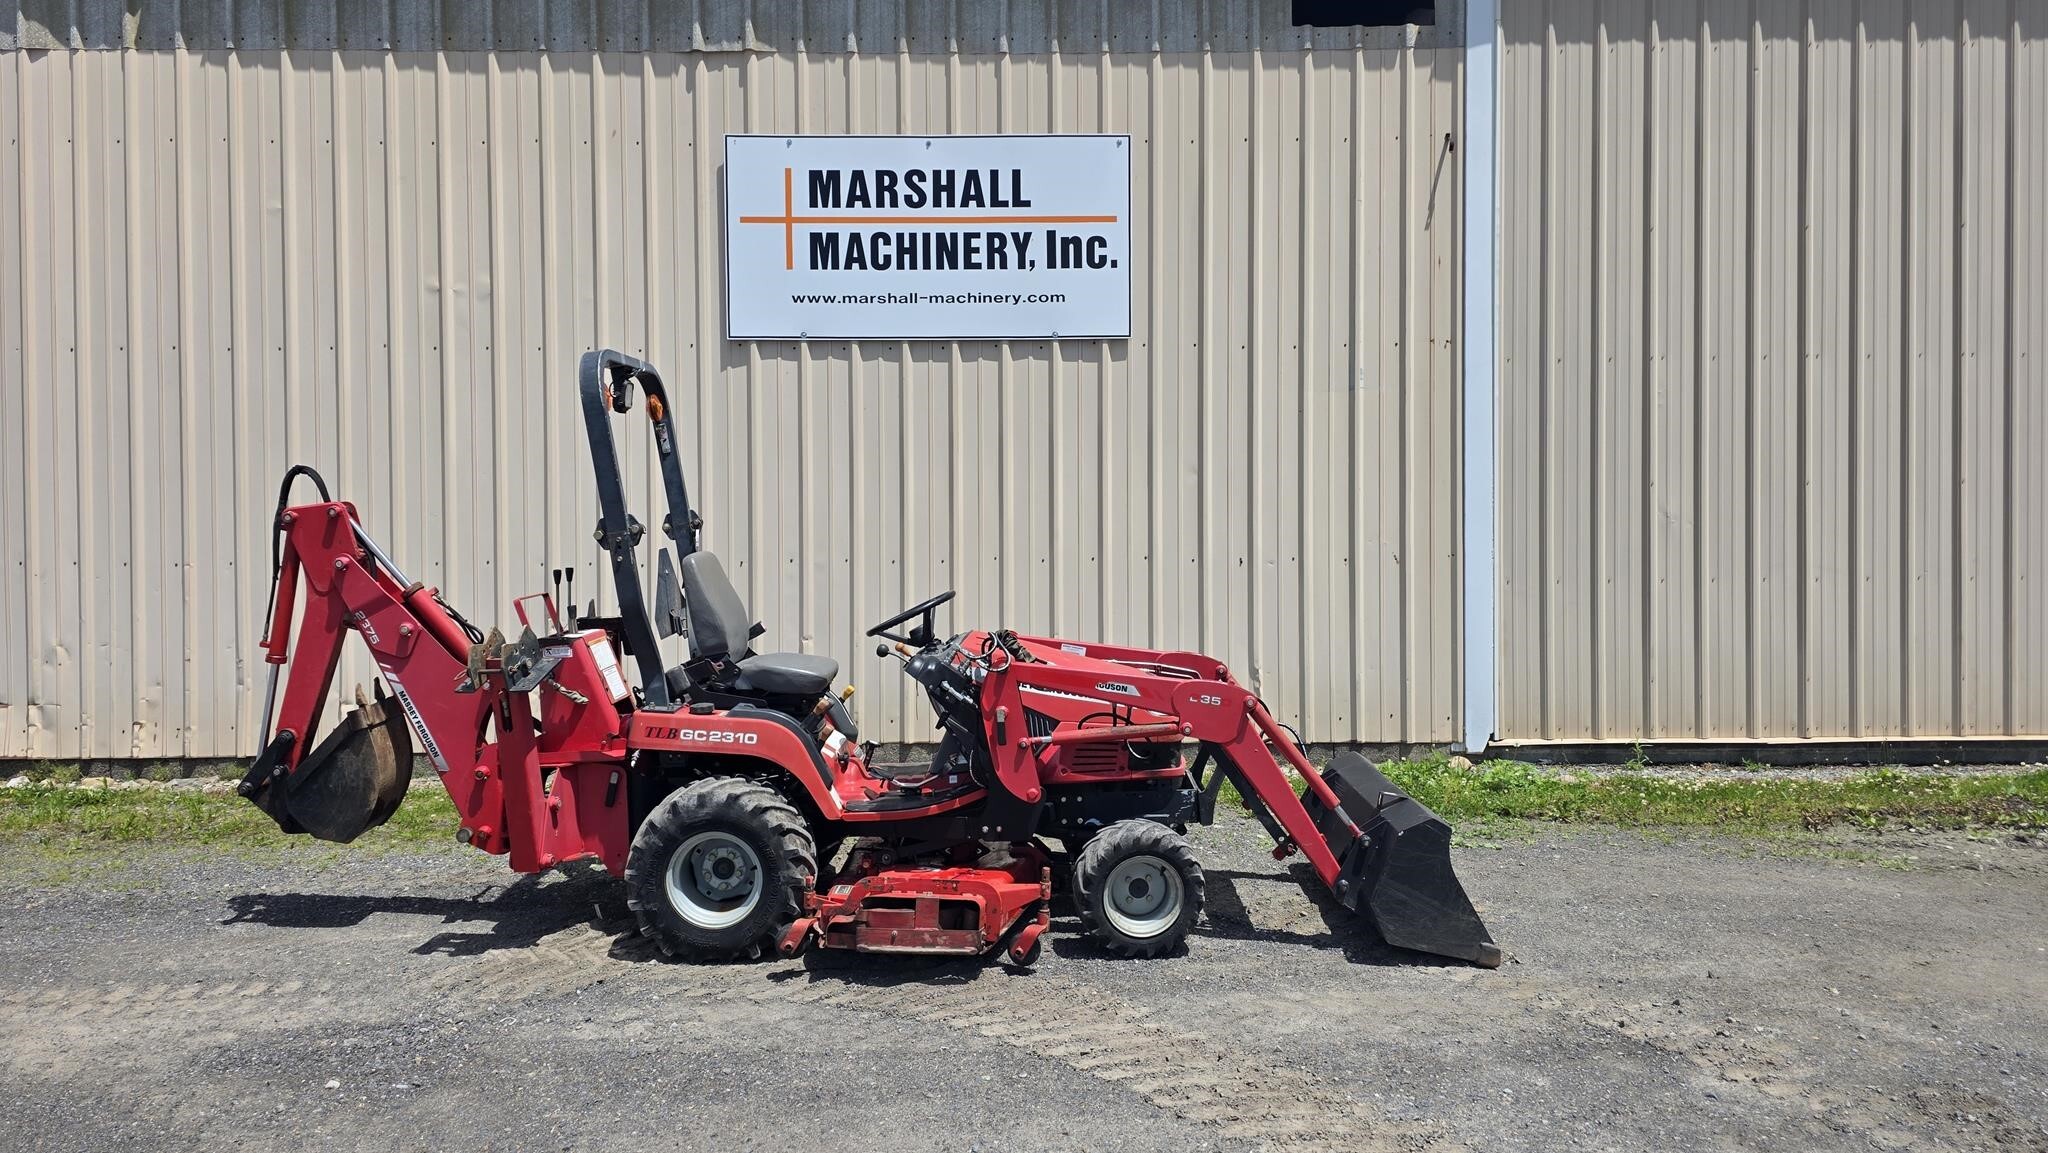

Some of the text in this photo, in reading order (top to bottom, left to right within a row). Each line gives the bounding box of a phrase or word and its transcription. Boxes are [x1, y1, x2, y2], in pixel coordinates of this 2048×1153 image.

[809, 169, 1031, 209] MARSHALL
[809, 230, 1118, 272] MACHINERY, Inc.
[791, 292, 1065, 305] www.marshall-machinery.com
[354, 611, 380, 645] 2375
[398, 691, 440, 759] MASSEY FERGUSON
[644, 726, 757, 745] TLB GC2310
